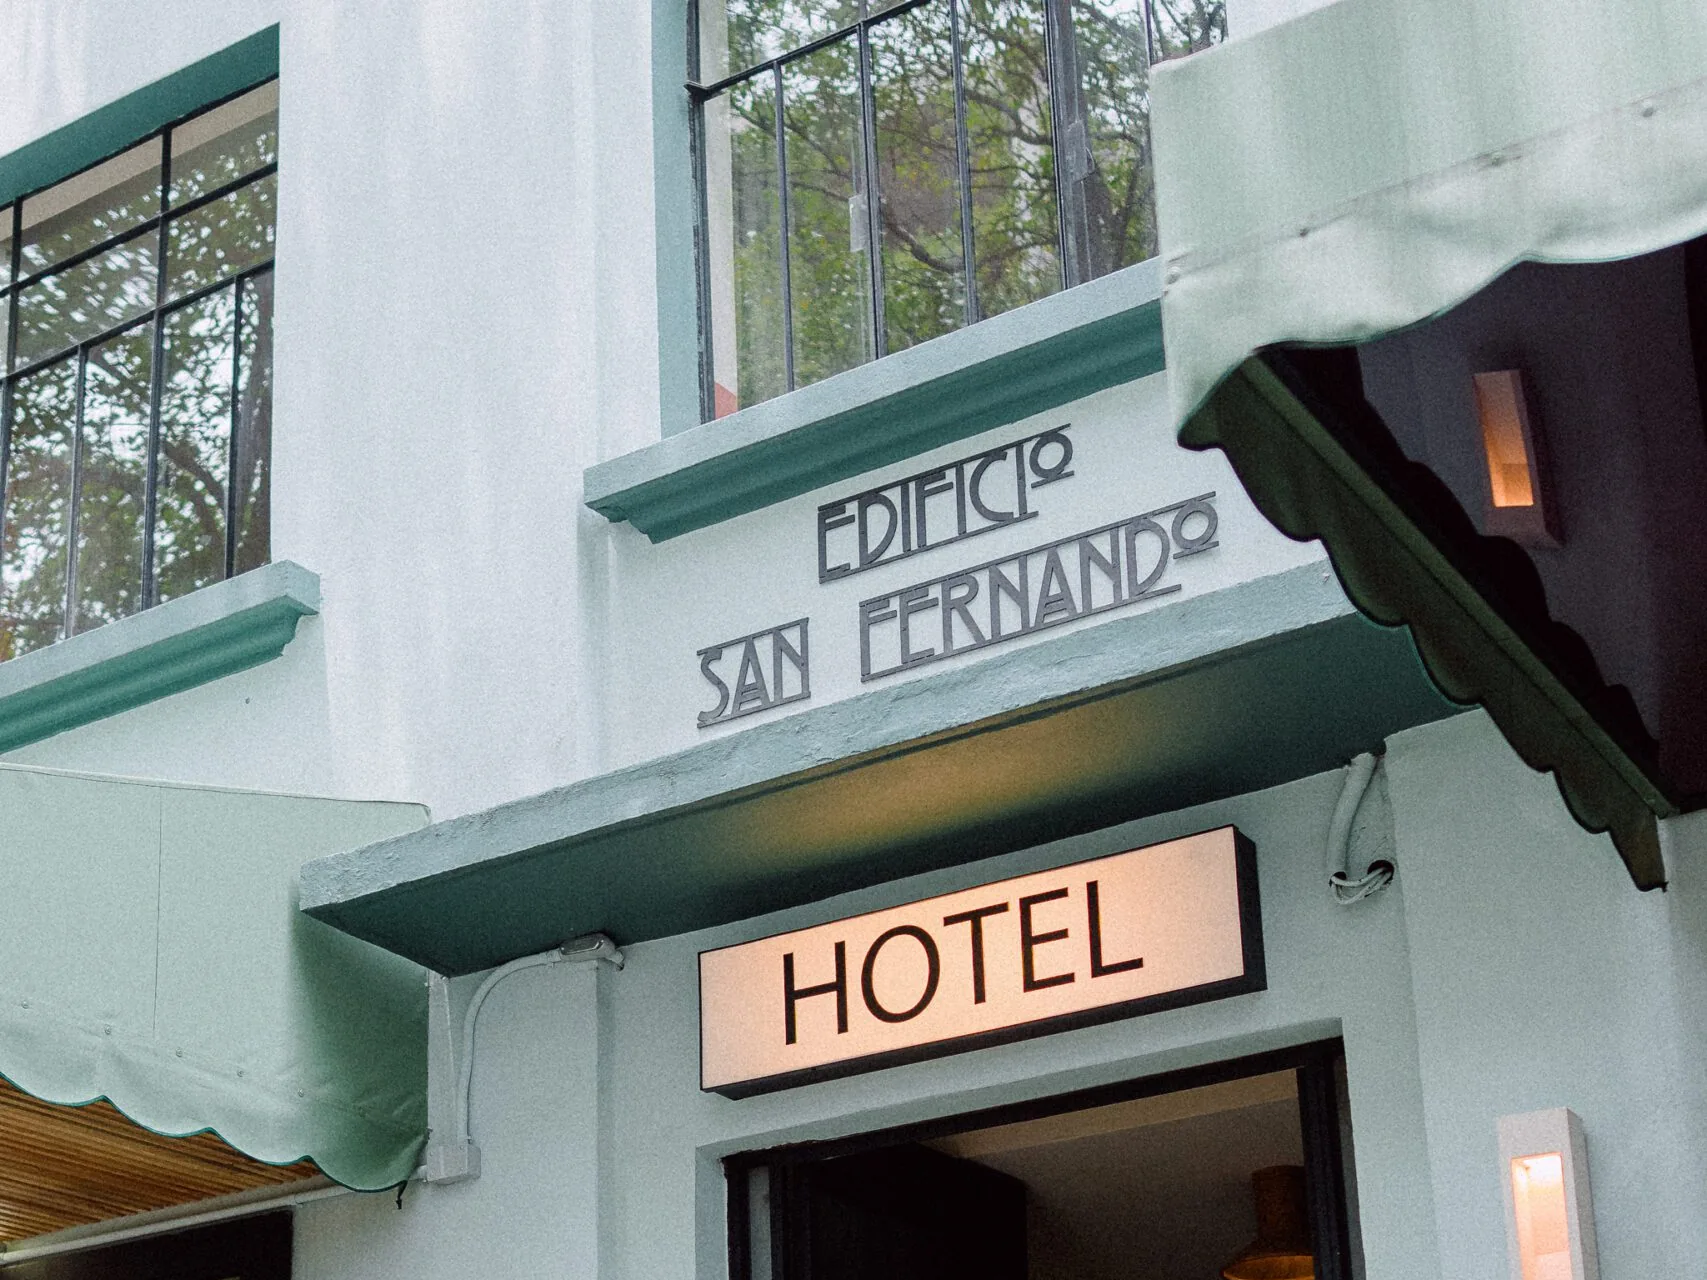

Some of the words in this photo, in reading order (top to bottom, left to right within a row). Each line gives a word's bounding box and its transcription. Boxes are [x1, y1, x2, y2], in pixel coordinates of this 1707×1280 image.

[817, 423, 1075, 584] EDIFICIO
[697, 617, 811, 729] SAN
[859, 491, 1219, 683] FERNANDO
[783, 880, 1144, 1045] HOTEL
